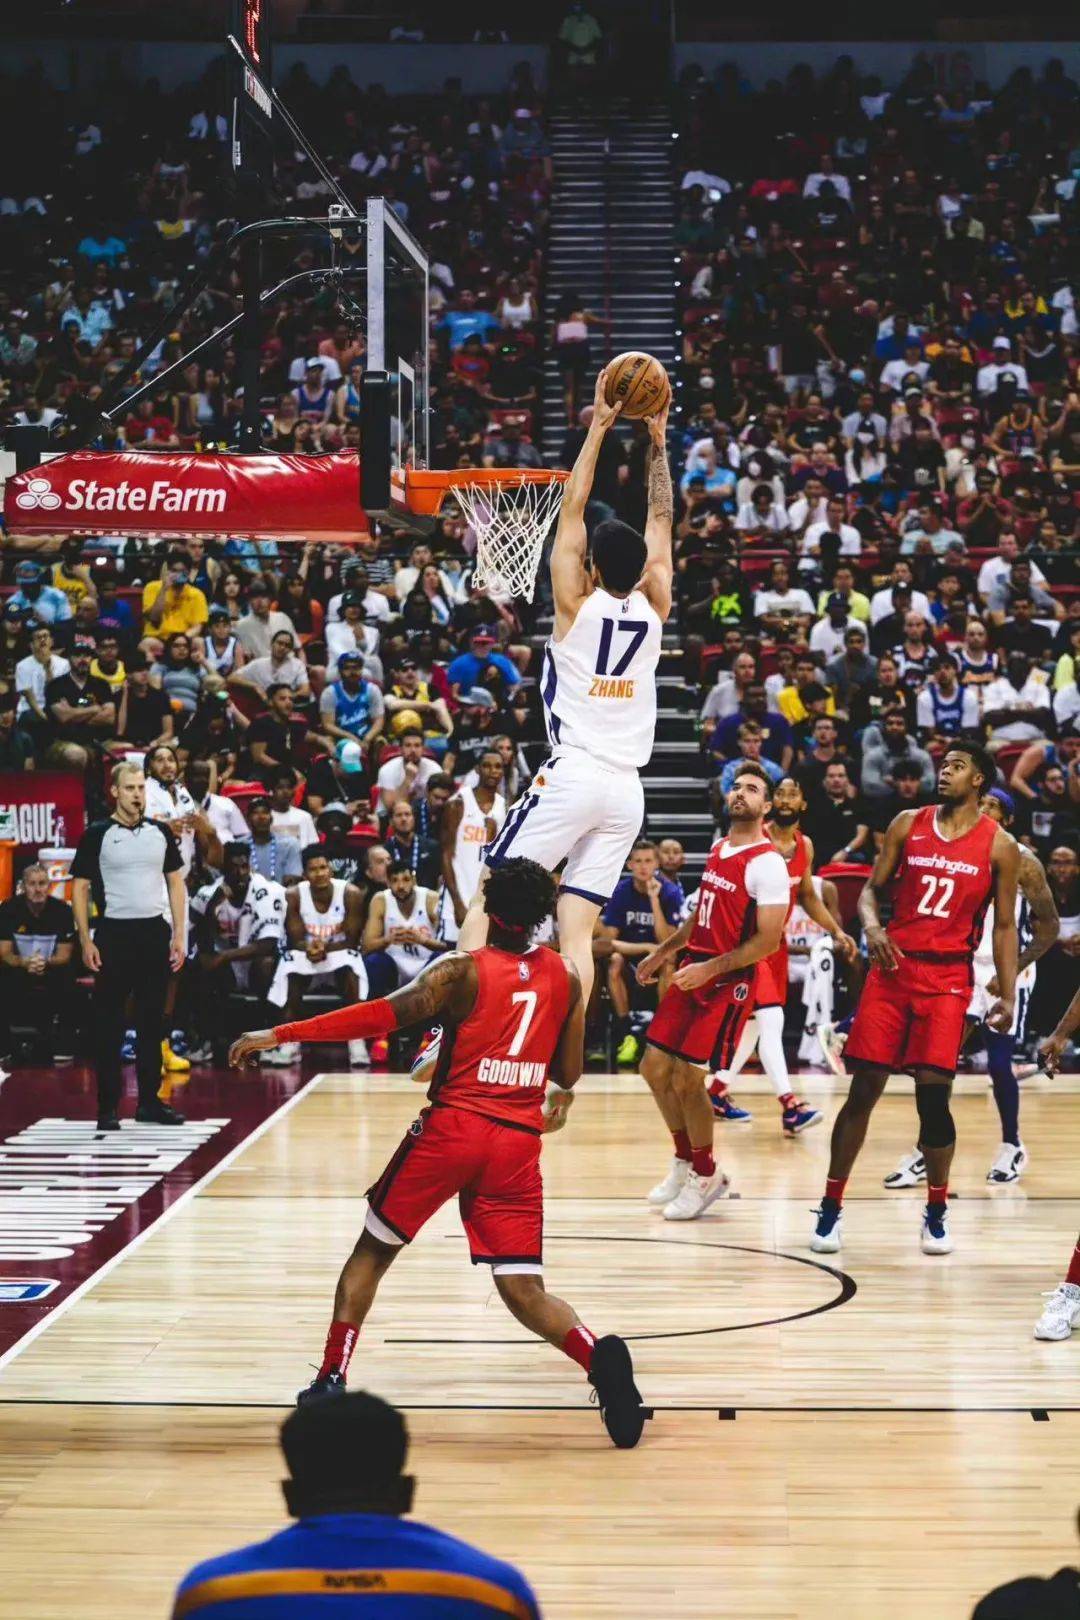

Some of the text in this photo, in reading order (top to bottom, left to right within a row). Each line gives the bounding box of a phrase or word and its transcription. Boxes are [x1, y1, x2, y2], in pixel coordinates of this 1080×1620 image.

[595, 617, 649, 677] 17
[588, 678, 634, 699] ZHANG
[907, 853, 979, 876] washington
[697, 889, 716, 929] 61
[917, 874, 955, 919] 22
[507, 991, 537, 1056] 7
[477, 1057, 547, 1087] GOODWIN
